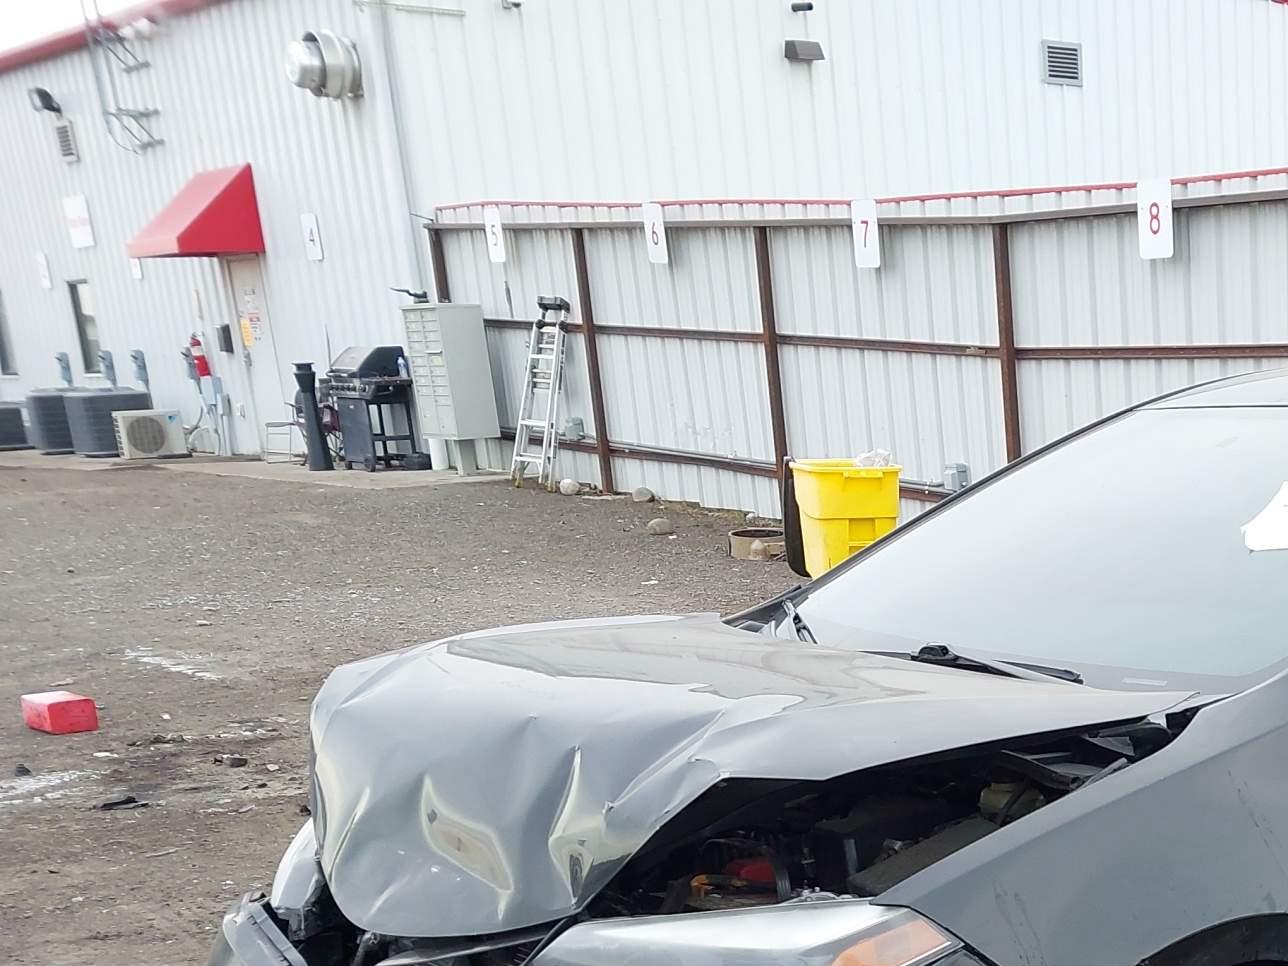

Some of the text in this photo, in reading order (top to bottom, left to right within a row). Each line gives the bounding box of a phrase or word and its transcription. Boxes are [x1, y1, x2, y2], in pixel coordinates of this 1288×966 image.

[1149, 202, 1161, 234] 8
[309, 227, 316, 247] 4
[491, 225, 498, 246] 5
[651, 222, 659, 246] 6
[860, 220, 869, 248] 7
